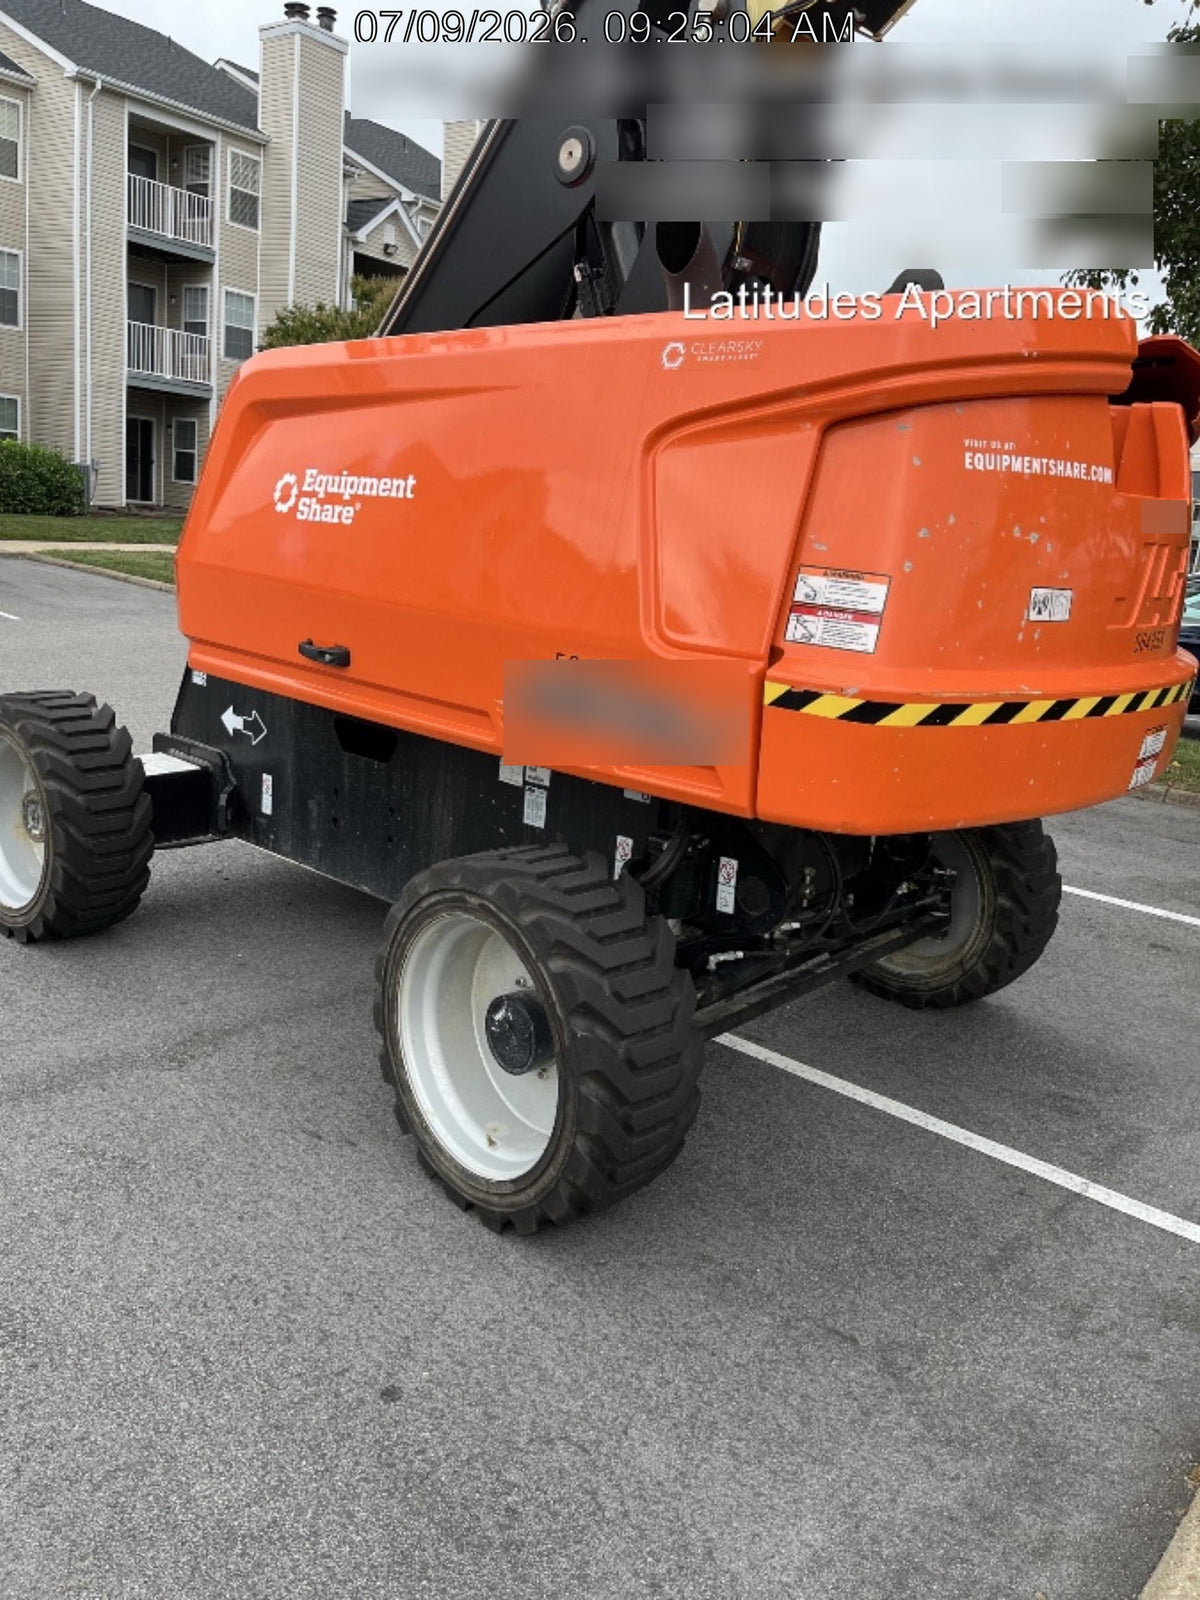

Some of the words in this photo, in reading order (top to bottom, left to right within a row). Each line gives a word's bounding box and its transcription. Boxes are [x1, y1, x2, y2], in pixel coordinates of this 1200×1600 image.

[690, 340, 764, 355] CLEARSKY
[302, 468, 417, 500] Equipment
[964, 452, 1113, 485] EQUIPMENTSHARE.COM
